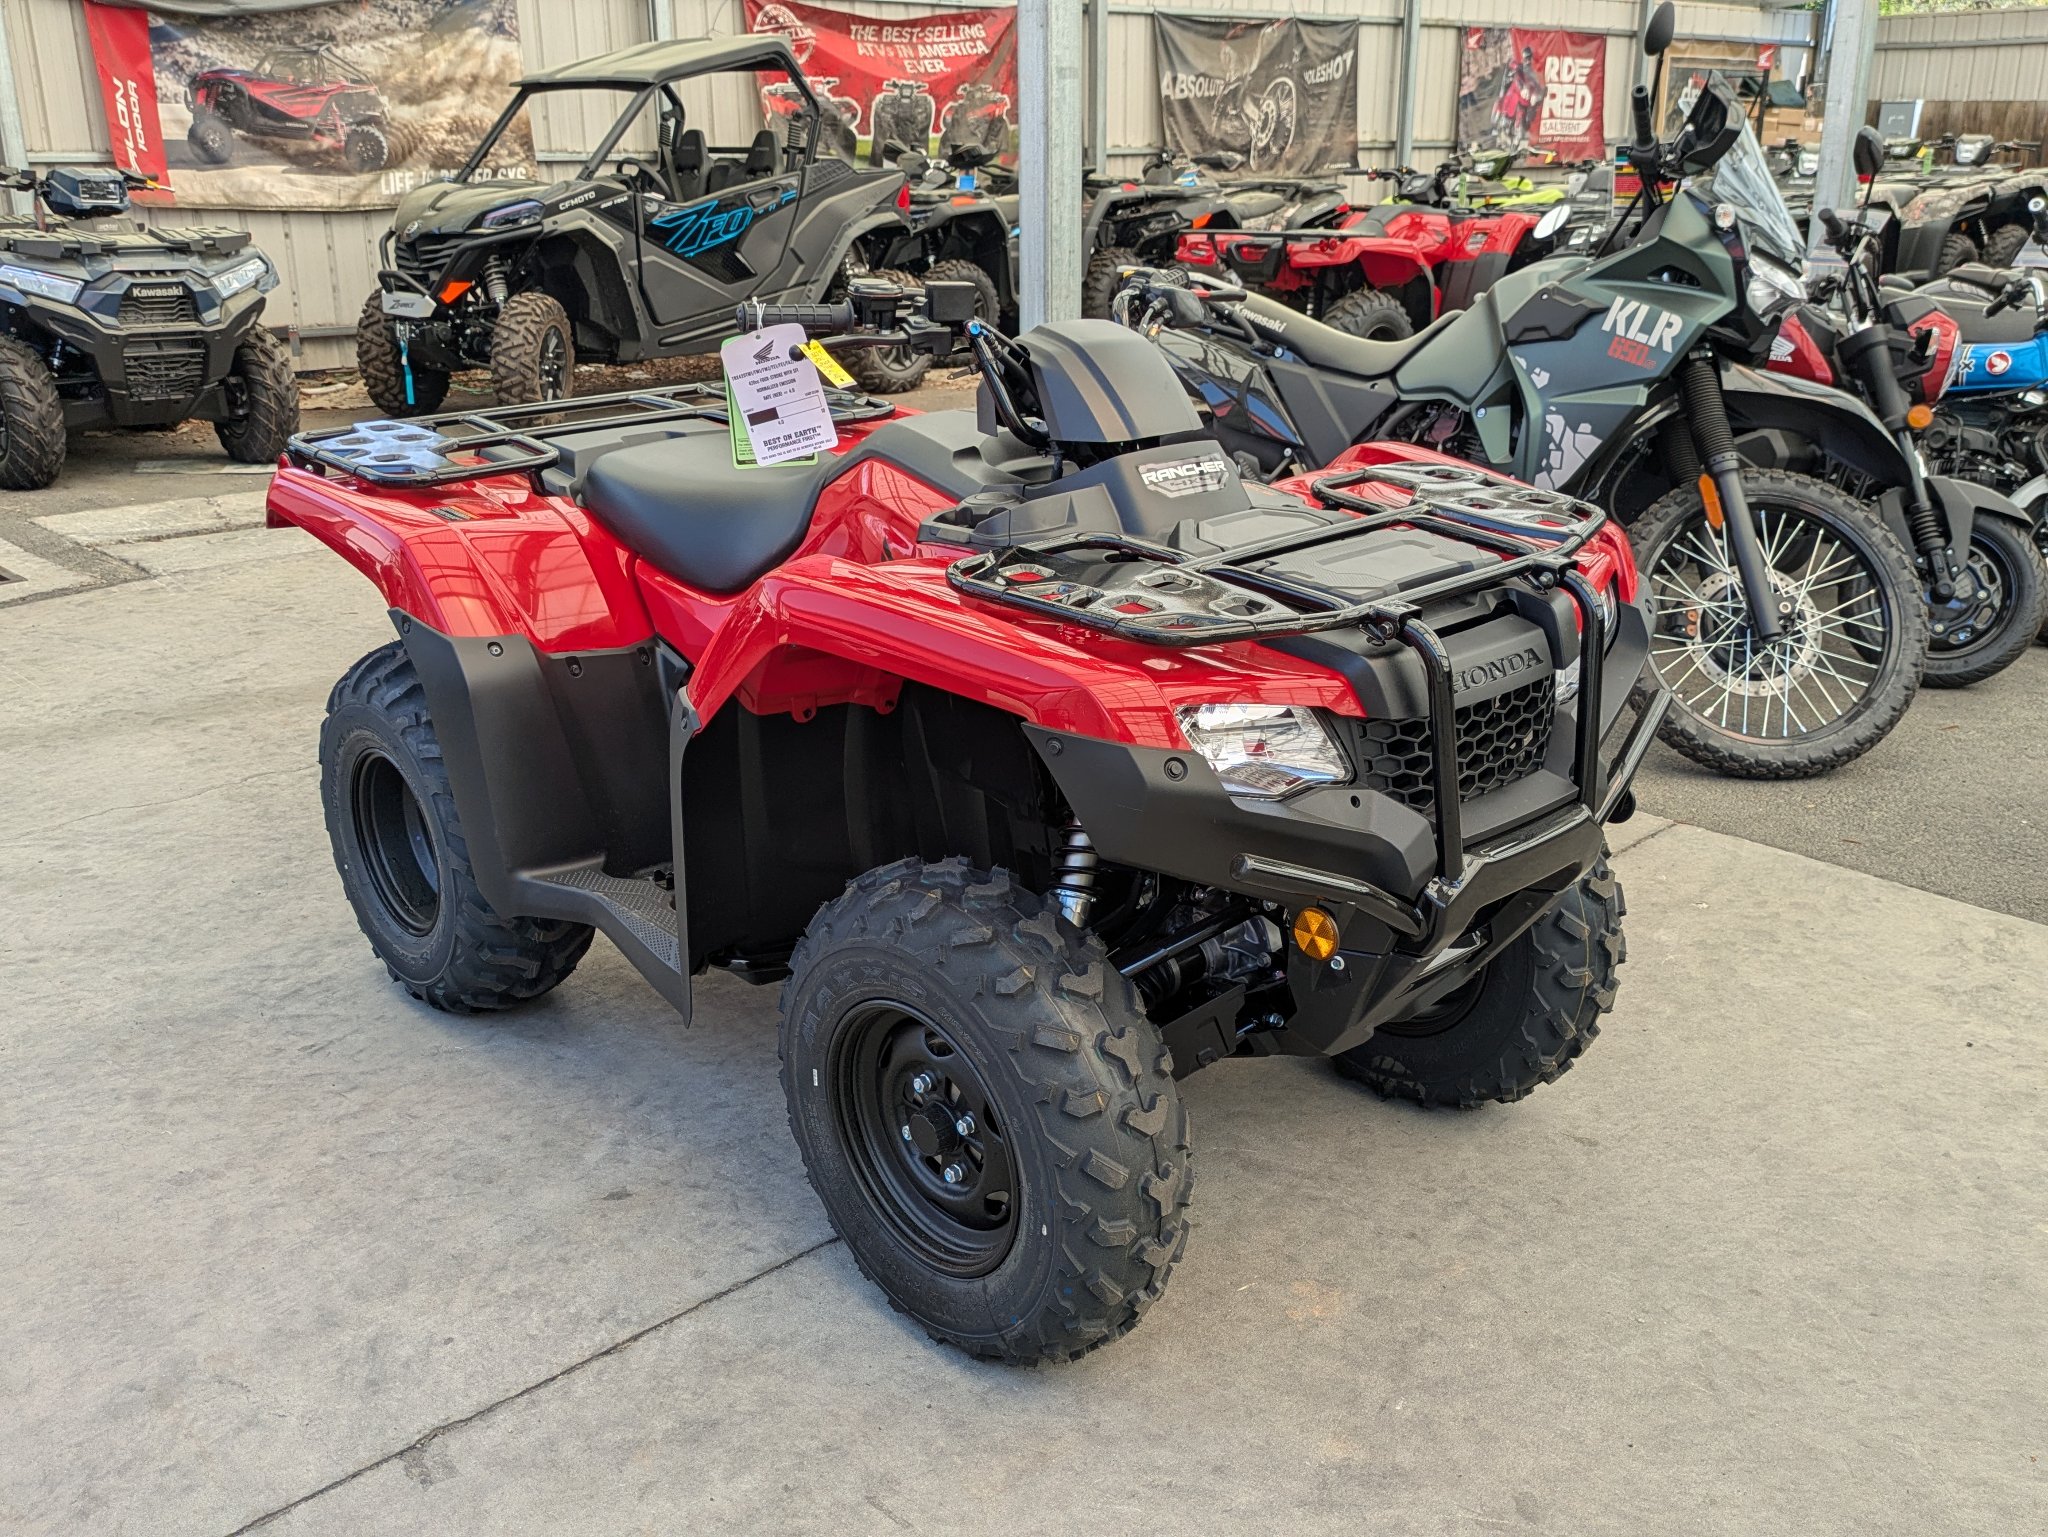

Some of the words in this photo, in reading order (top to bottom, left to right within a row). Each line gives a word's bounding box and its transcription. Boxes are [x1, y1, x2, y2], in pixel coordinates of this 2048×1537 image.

[849, 25, 879, 41] THE
[882, 24, 987, 43] BEST-SELLING
[896, 44, 915, 59] IN
[917, 41, 990, 59] AMERICA
[903, 58, 952, 74] EVER.
[1161, 70, 1225, 100] ABSOLUT
[1541, 83, 1593, 119] RED
[380, 171, 414, 195] LIFE
[558, 190, 596, 211] CFMOTO
[132, 286, 184, 298] Kawasaki
[1234, 303, 1288, 333] Kawasaki
[1601, 295, 1684, 354] KLR
[755, 355, 781, 366] HONDA
[1607, 335, 1650, 367] 650
[762, 435, 782, 446] BEST
[782, 433, 792, 441] ON
[766, 437, 802, 452] PERFORMANCE
[1141, 460, 1228, 485] RANCHER
[1453, 647, 1545, 695] HONDA
